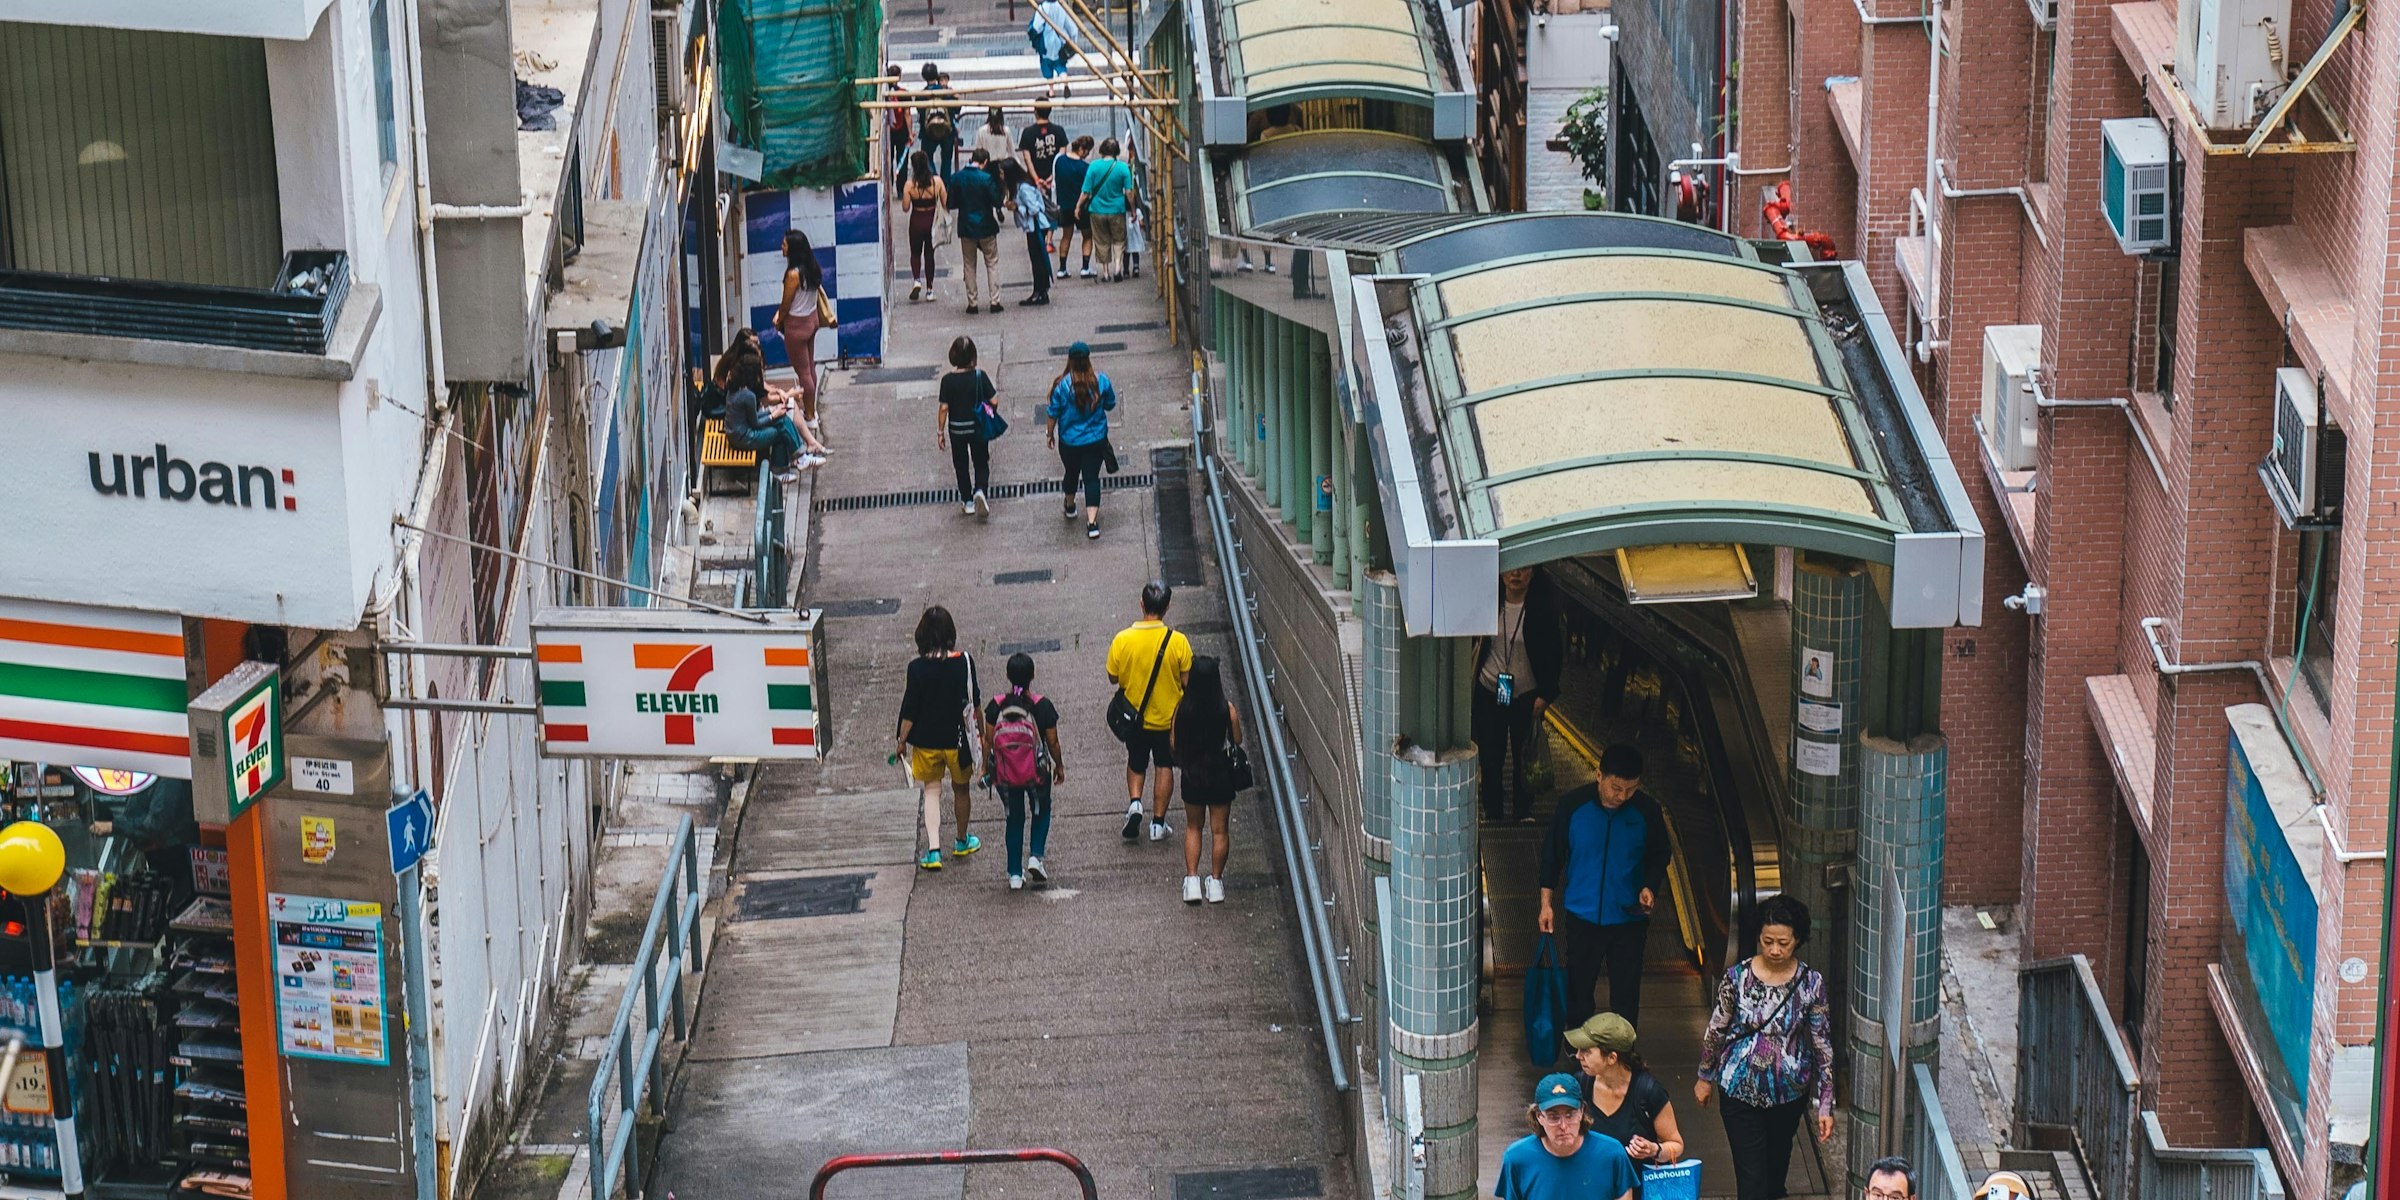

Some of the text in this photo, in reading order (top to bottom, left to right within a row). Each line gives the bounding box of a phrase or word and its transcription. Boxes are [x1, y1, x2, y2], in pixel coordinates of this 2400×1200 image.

[633, 643, 714, 745] 7
[303, 769, 341, 778] Elgin Street
[316, 778, 330, 791] 40
[1643, 1168, 1691, 1182] bakehouse
